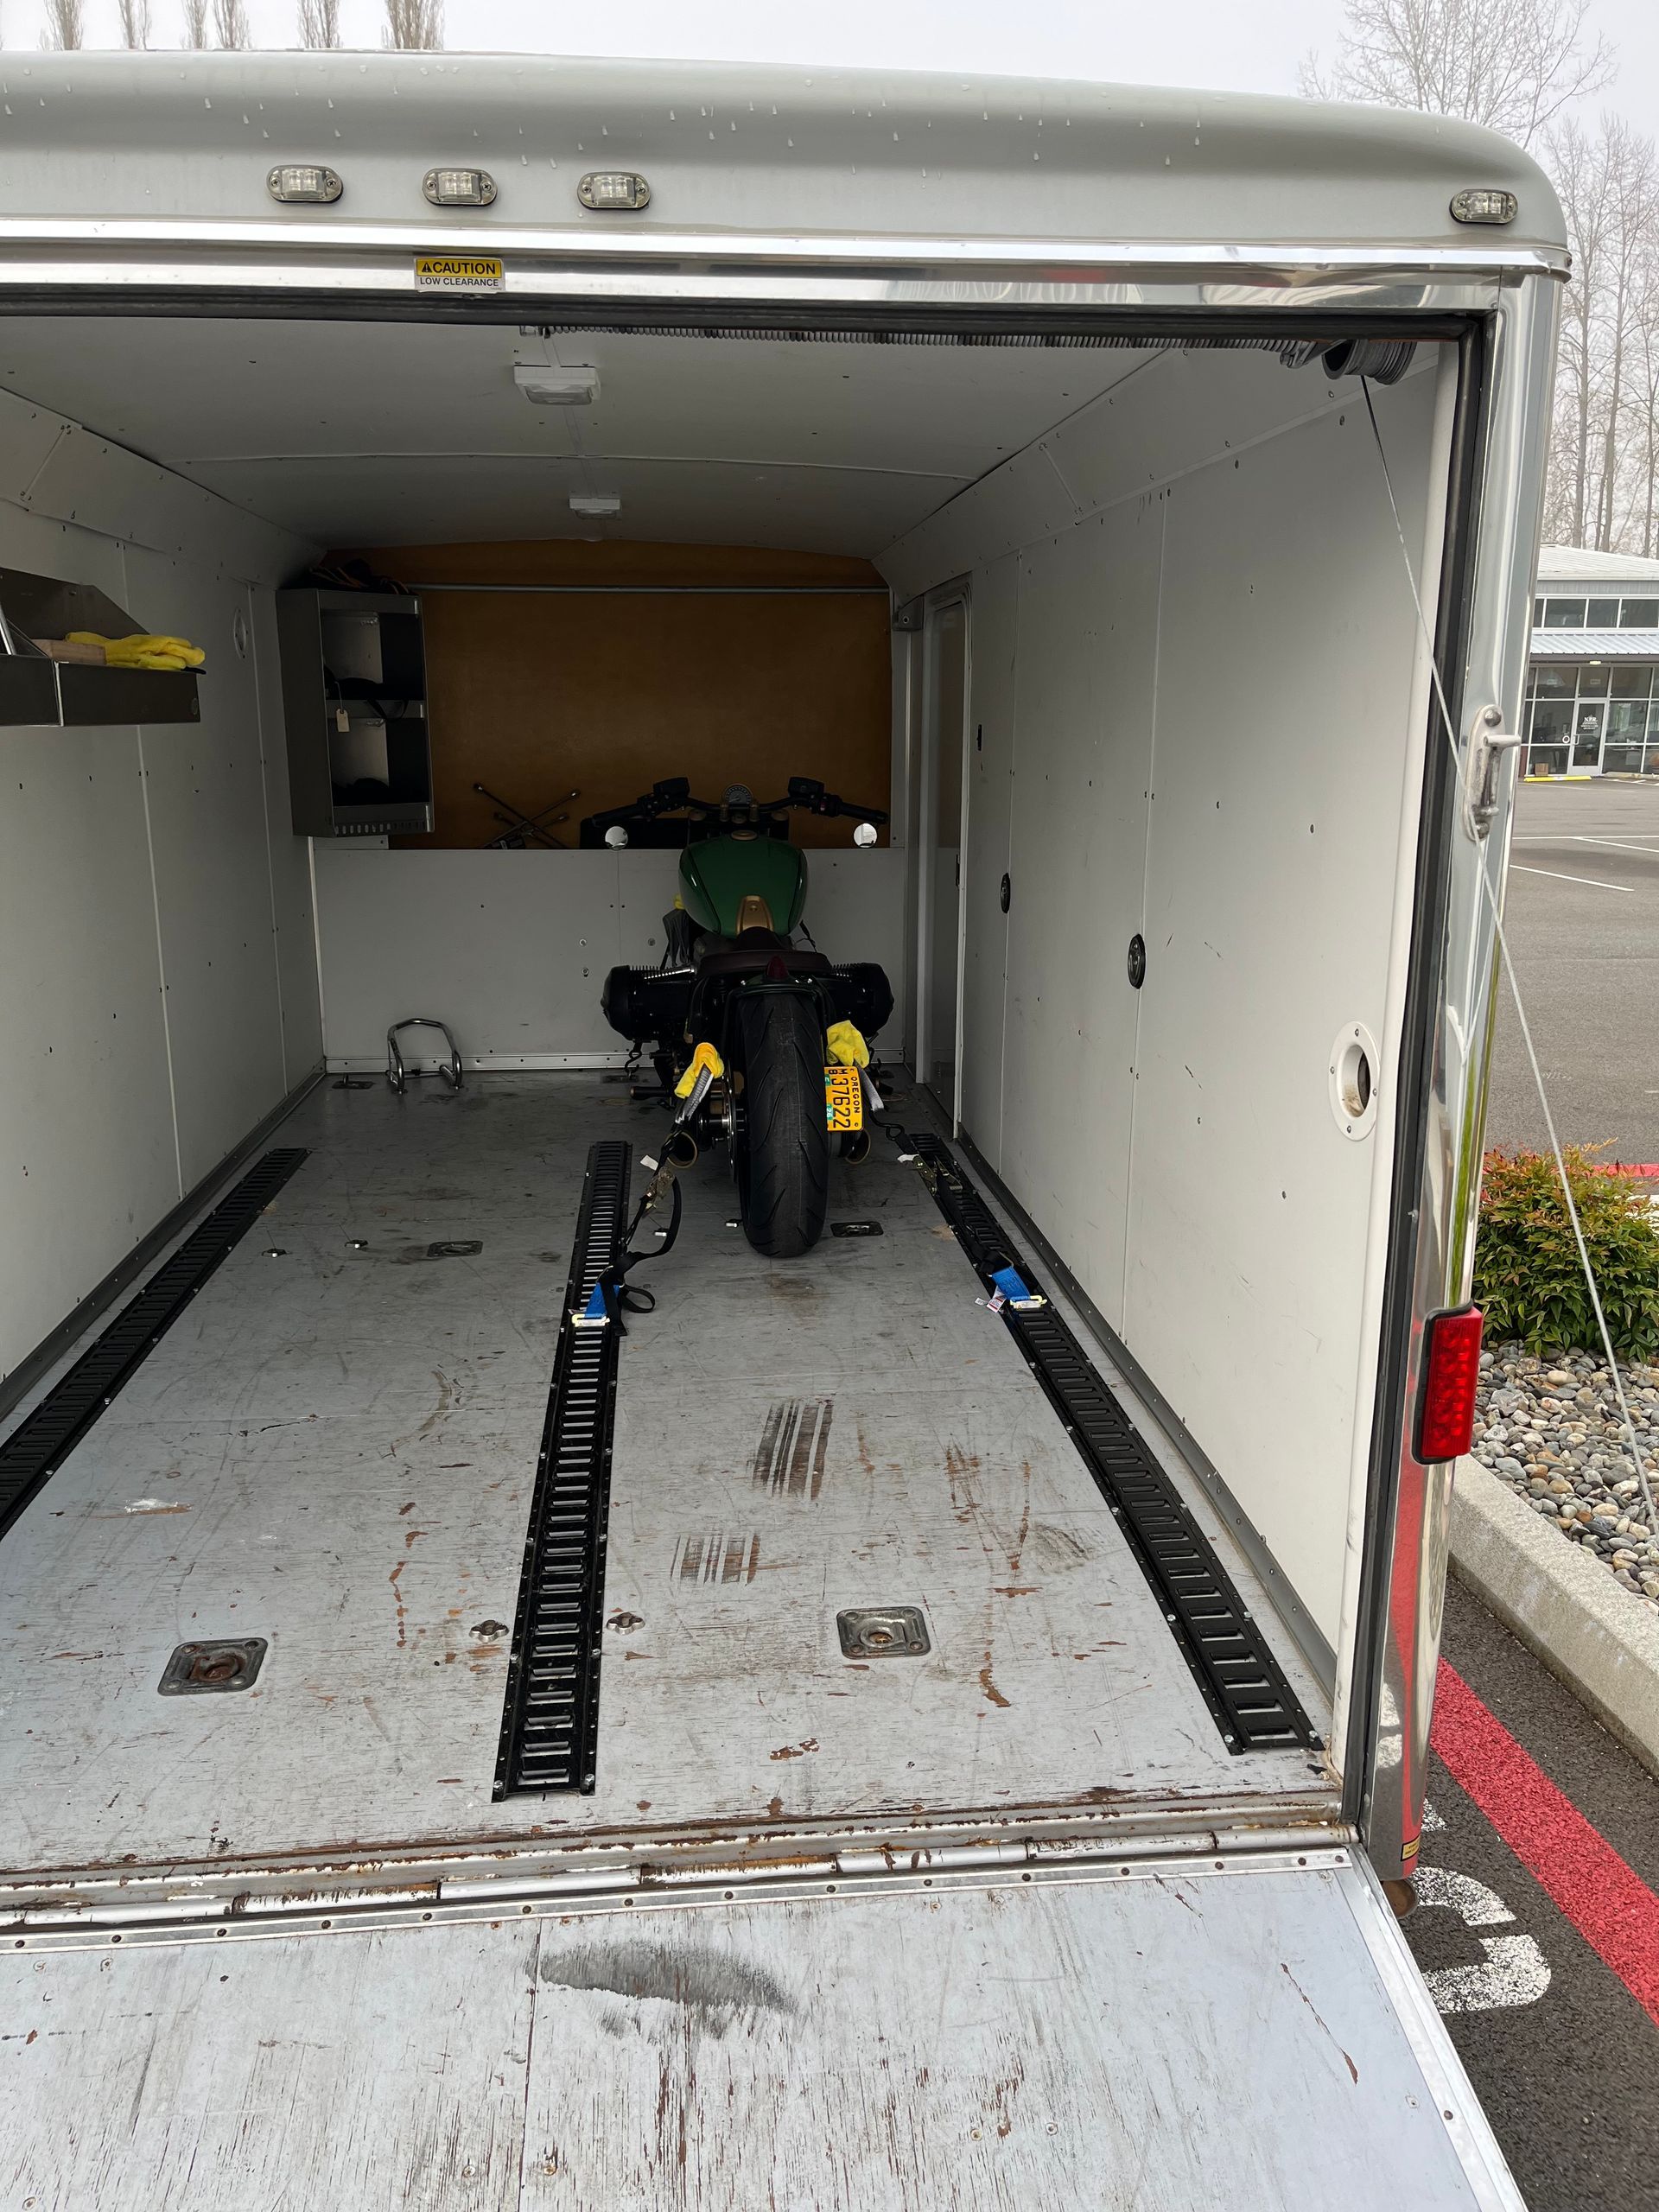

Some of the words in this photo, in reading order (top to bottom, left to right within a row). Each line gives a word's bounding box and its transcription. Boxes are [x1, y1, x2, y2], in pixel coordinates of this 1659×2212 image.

[433, 262, 495, 274] CAUTION
[443, 278, 499, 287] CLEARANCE
[831, 1077, 850, 1128] 37622
[851, 1077, 860, 1113] OREGON
